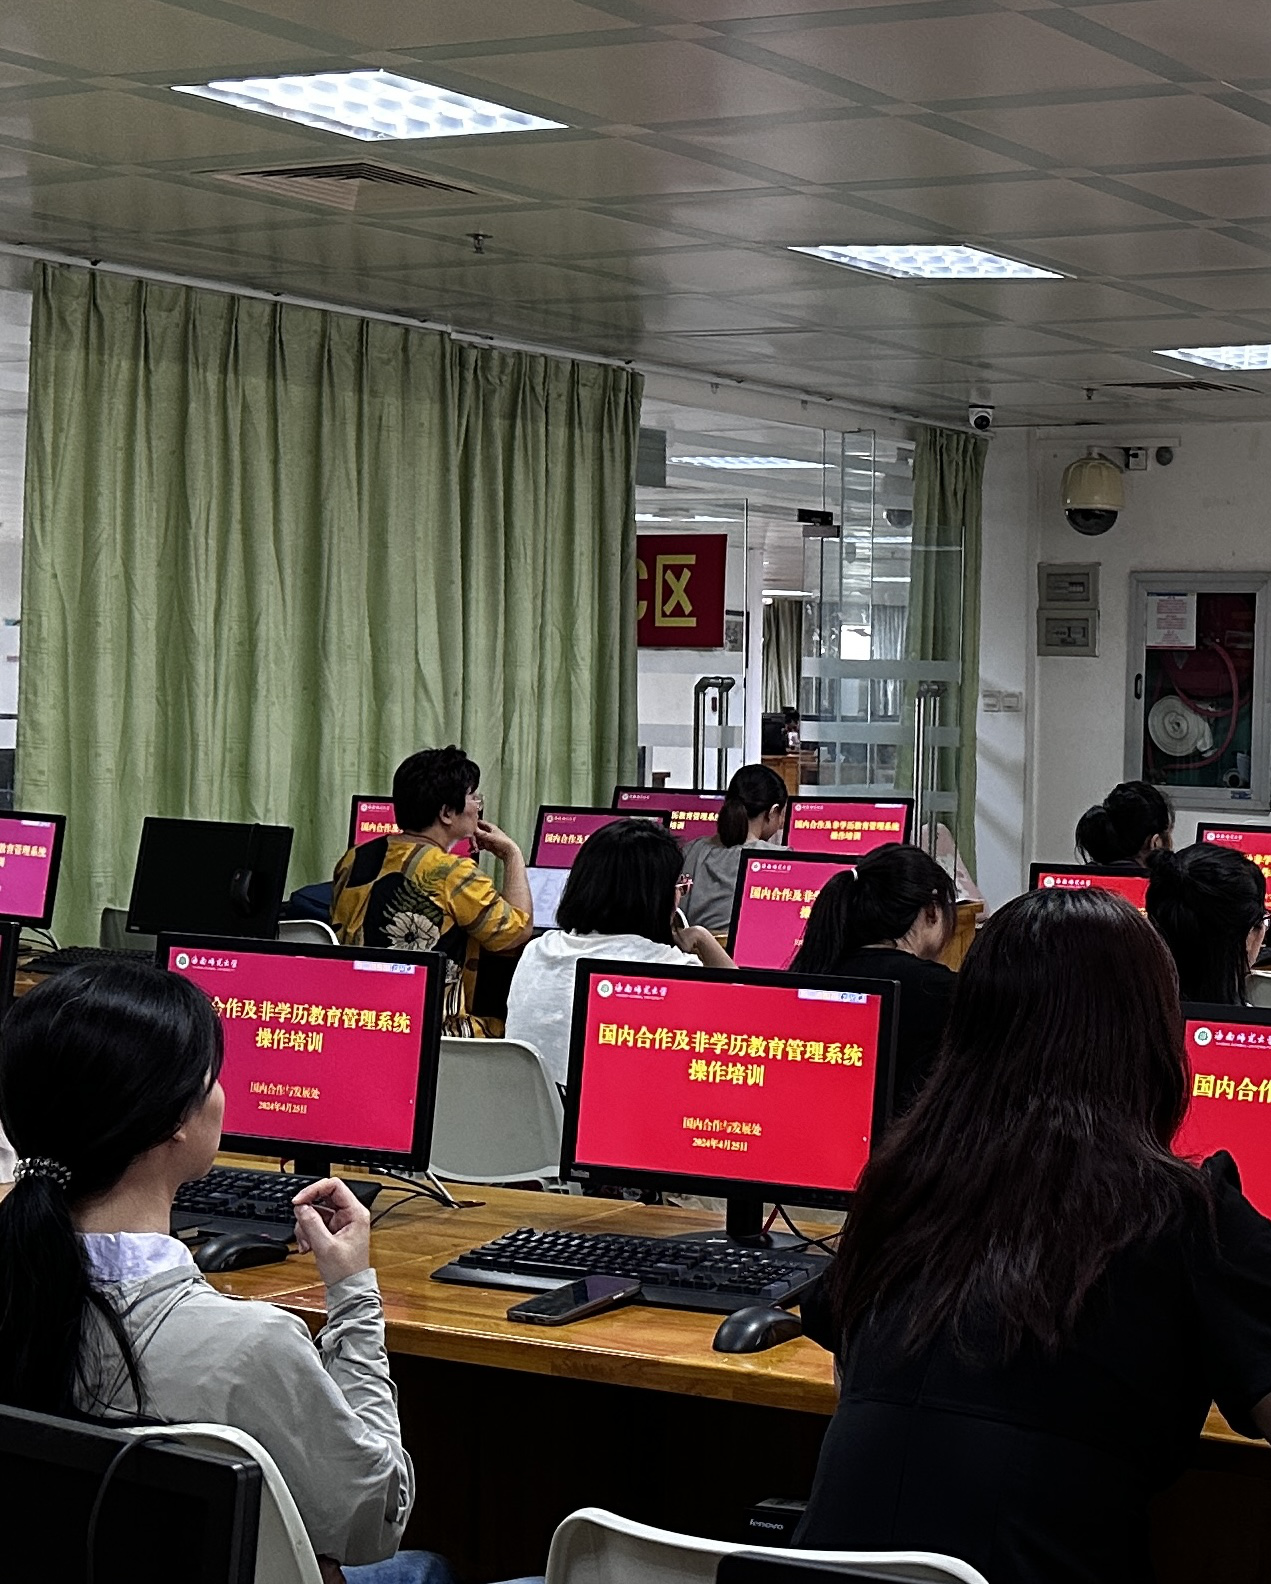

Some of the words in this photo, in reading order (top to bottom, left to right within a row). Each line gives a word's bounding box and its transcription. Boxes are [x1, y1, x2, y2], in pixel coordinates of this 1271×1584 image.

[255, 1026, 325, 1054] 操作培训
[597, 1022, 864, 1068] 国内合作及非学历教育管理系统
[687, 1058, 766, 1088] 操作培训
